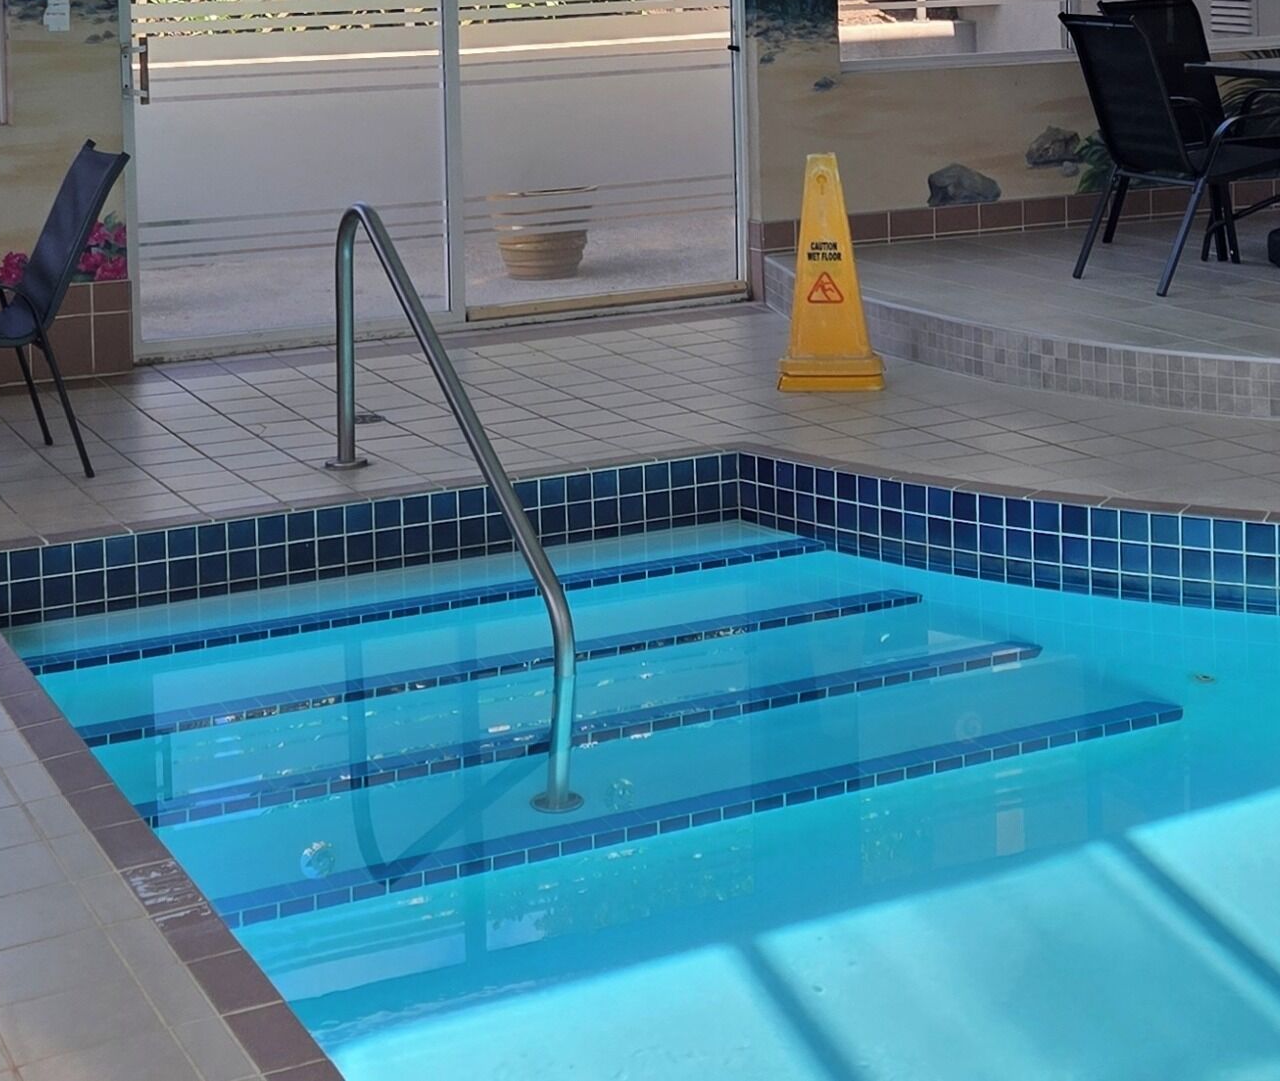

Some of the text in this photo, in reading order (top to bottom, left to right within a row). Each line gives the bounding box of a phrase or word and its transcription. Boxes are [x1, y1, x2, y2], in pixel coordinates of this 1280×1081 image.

[811, 242, 837, 250] CAUTION
[808, 252, 842, 261] WET FLOOR
